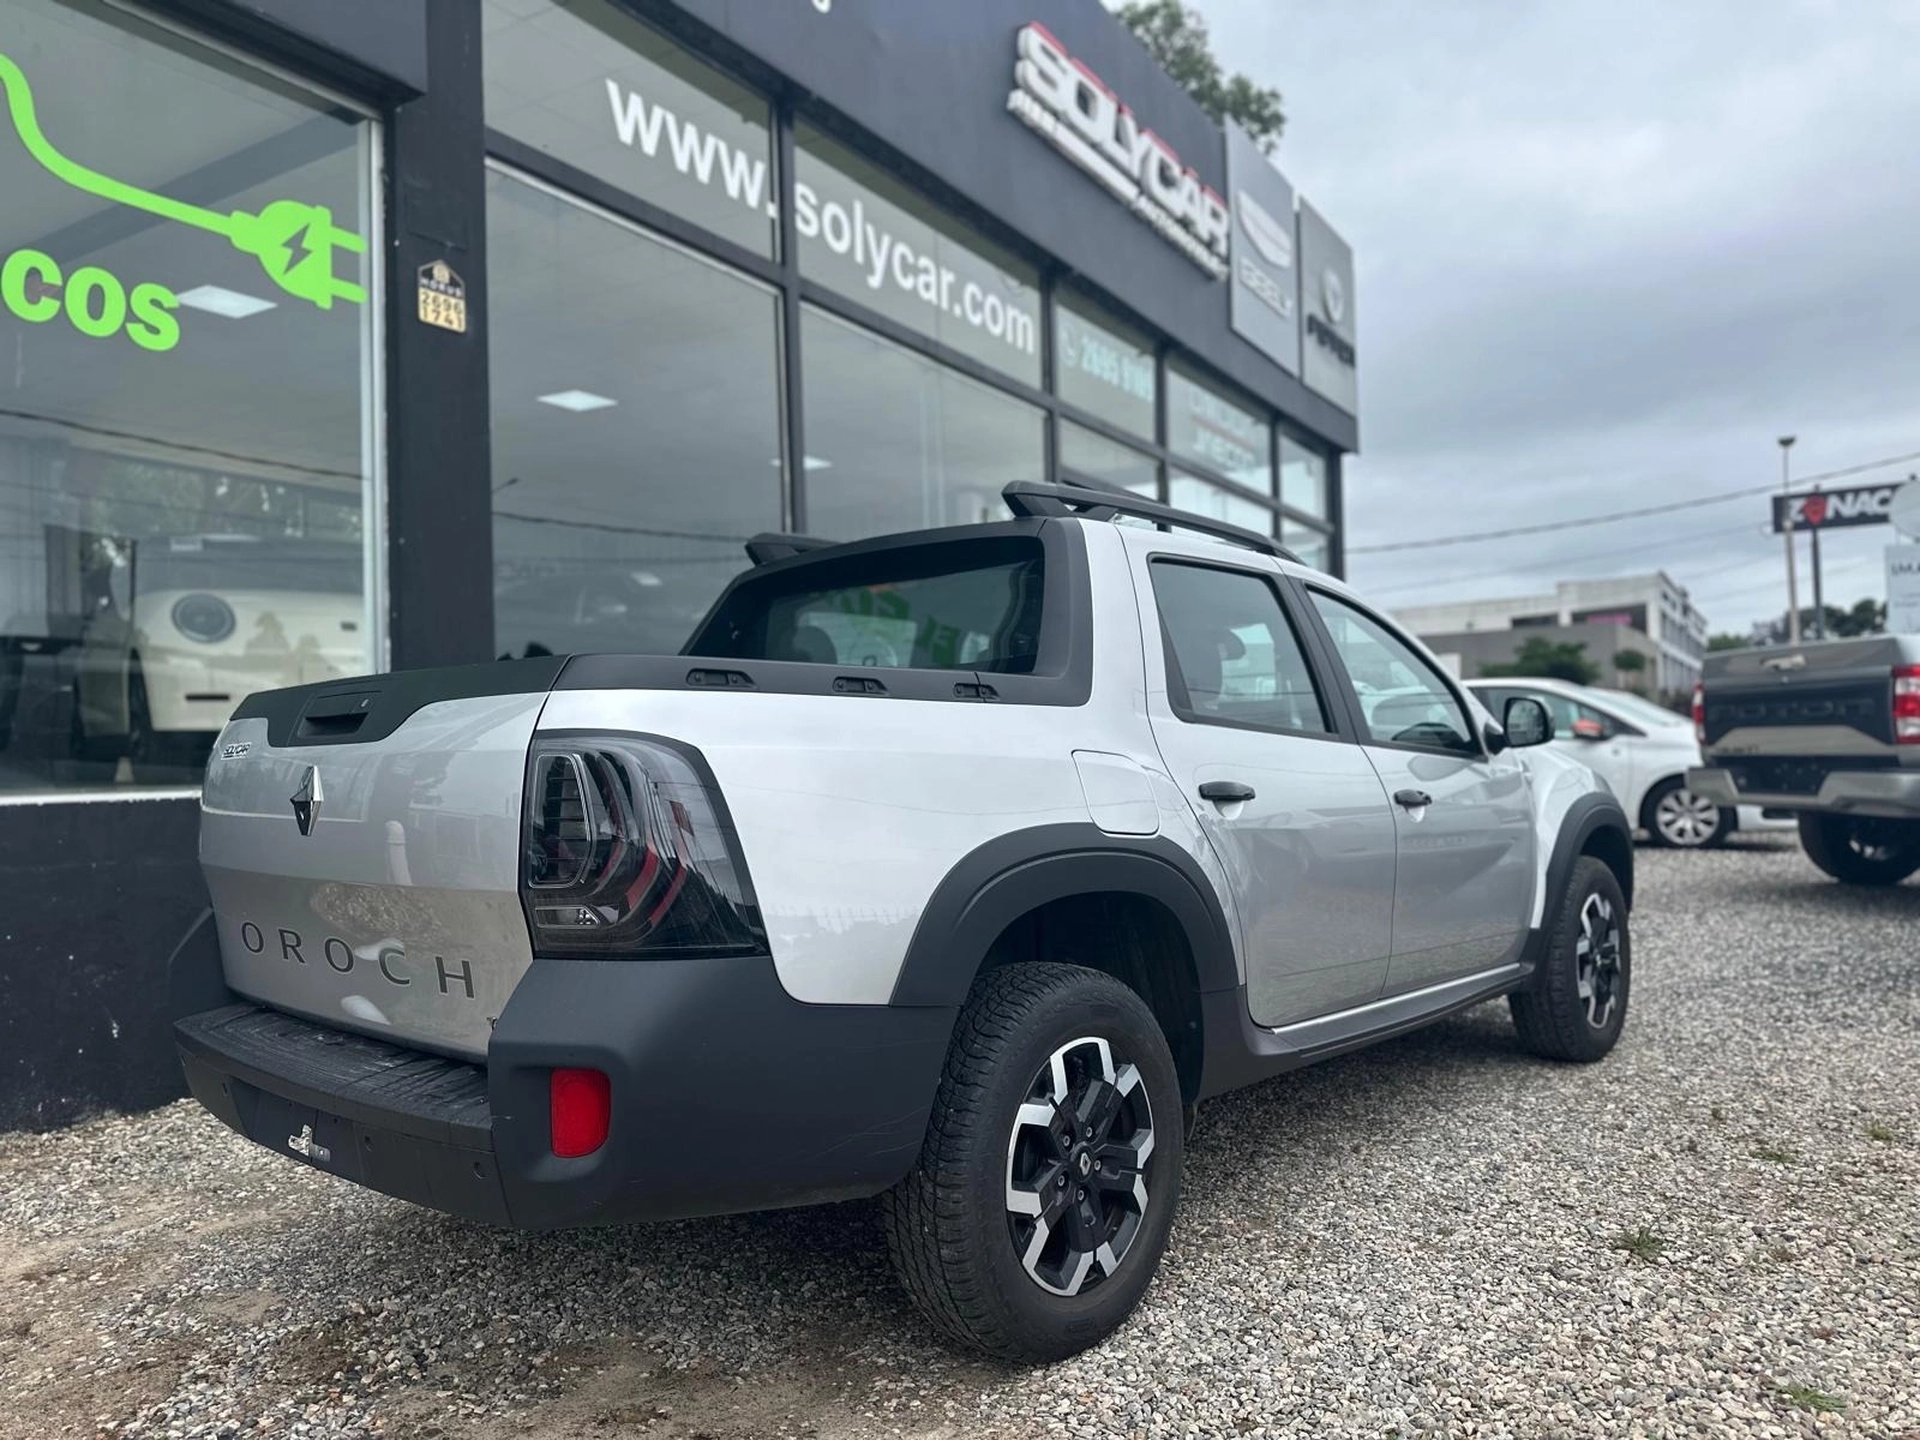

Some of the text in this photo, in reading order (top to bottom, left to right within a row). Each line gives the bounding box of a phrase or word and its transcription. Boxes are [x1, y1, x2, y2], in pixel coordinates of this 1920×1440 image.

[1016, 21, 1229, 250] SOLYCAR
[2, 249, 179, 351] cos
[240, 921, 475, 998] OROCH
